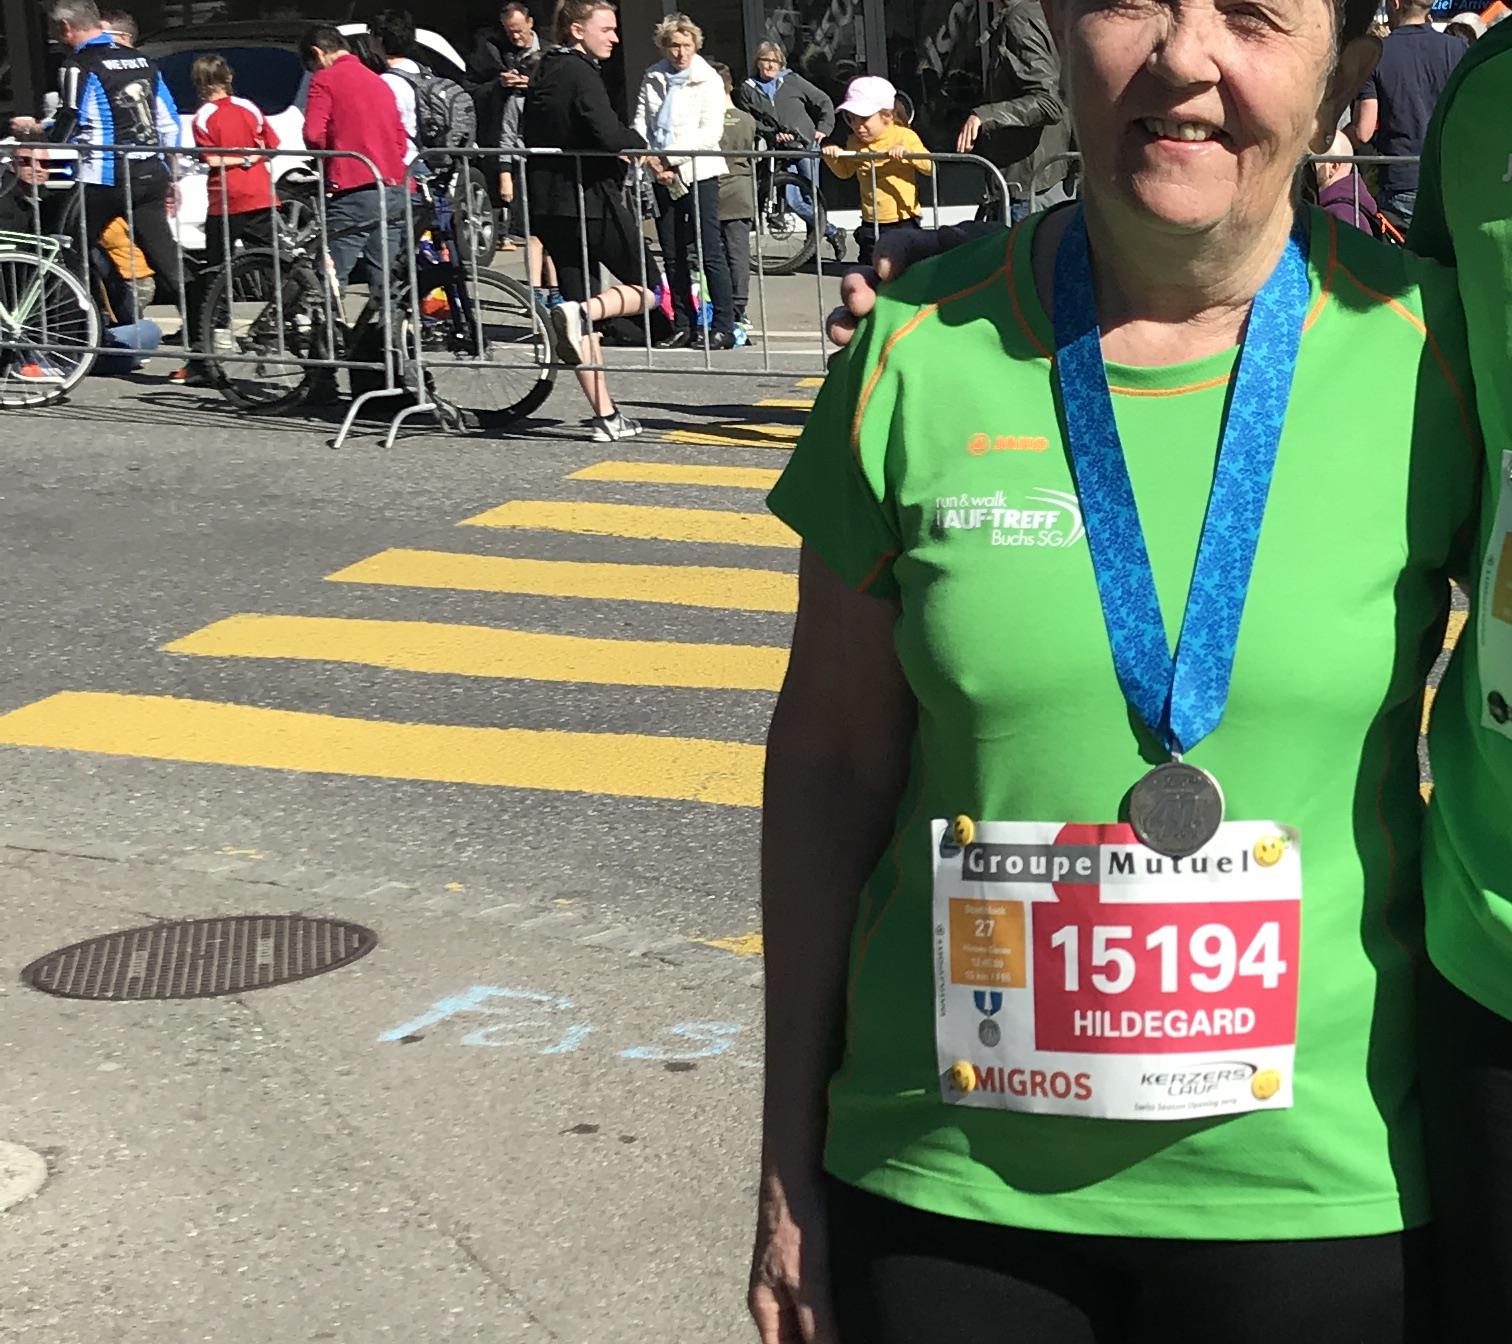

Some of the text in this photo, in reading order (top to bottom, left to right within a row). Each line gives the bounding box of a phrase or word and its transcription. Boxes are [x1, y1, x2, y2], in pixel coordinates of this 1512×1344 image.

[971, 490, 1008, 508] walk
[991, 529, 1063, 547] Buchs SG
[968, 848, 1249, 881] Groupe Mutuel
[975, 919, 995, 937] 27
[1050, 921, 1287, 994] 15194
[1073, 1007, 1256, 1039] HILDEGARD
[972, 1063, 1093, 1101] MIGROS
[1140, 1067, 1247, 1086] KERZERS
